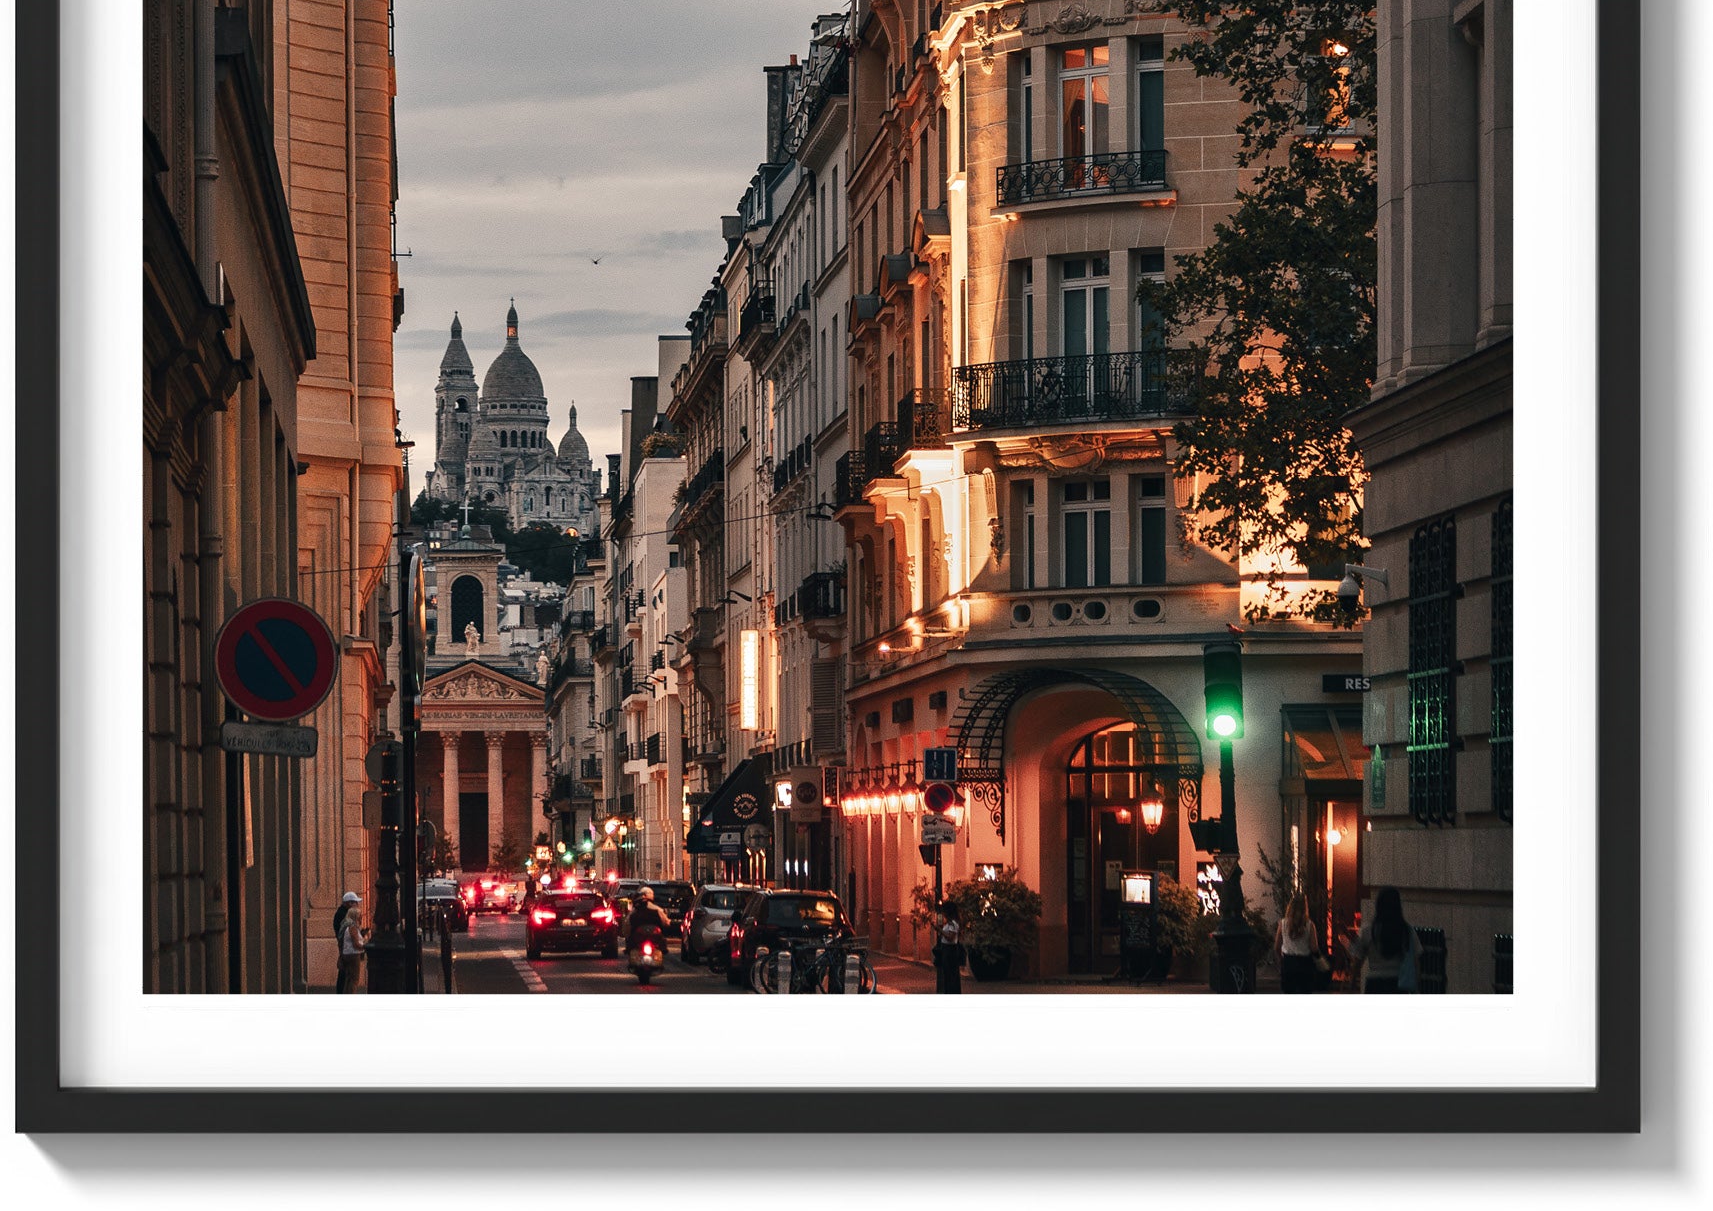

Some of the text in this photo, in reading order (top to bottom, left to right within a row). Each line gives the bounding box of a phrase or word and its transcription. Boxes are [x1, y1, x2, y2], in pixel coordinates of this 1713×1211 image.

[1345, 678, 1371, 690] RES
[434, 712, 462, 720] MARIAE
[465, 712, 493, 720] VIRGINI
